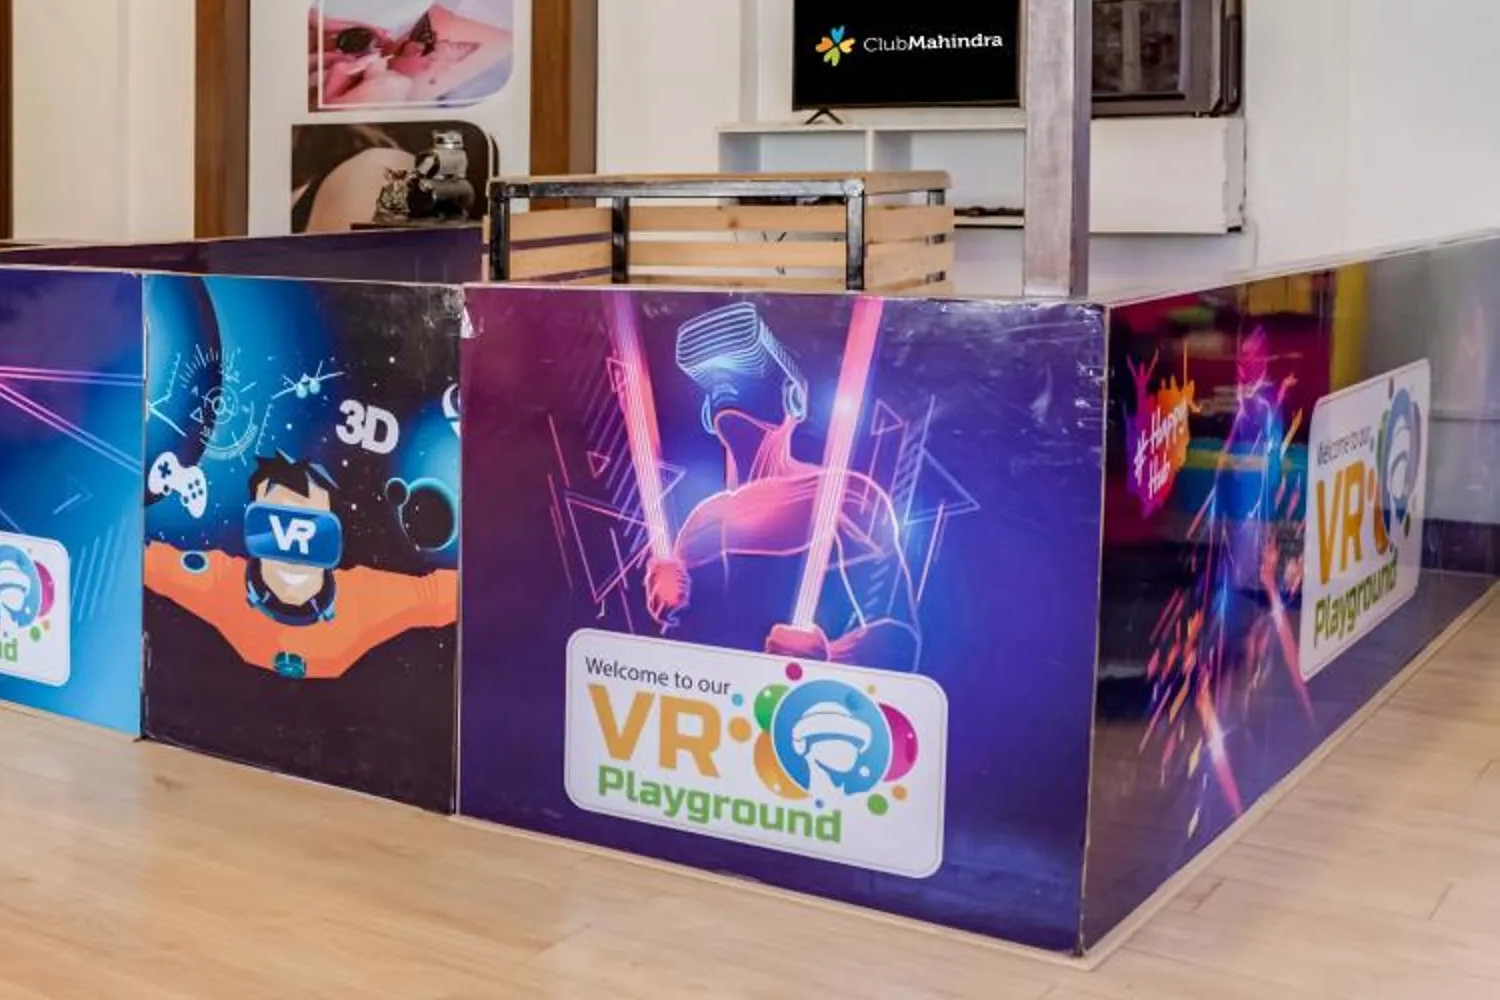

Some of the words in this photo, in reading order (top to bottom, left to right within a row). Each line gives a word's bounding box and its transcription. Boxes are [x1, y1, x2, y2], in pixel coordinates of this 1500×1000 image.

[335, 398, 400, 455] 3D
[1148, 451, 1171, 500] Hub
[268, 513, 318, 556] VR
[1316, 460, 1366, 586] VR
[1314, 549, 1398, 648] Playground
[585, 655, 669, 686] Welcome
[674, 673, 693, 690] to
[697, 676, 731, 695] our
[587, 682, 721, 779] VR
[598, 764, 842, 843] Playground
